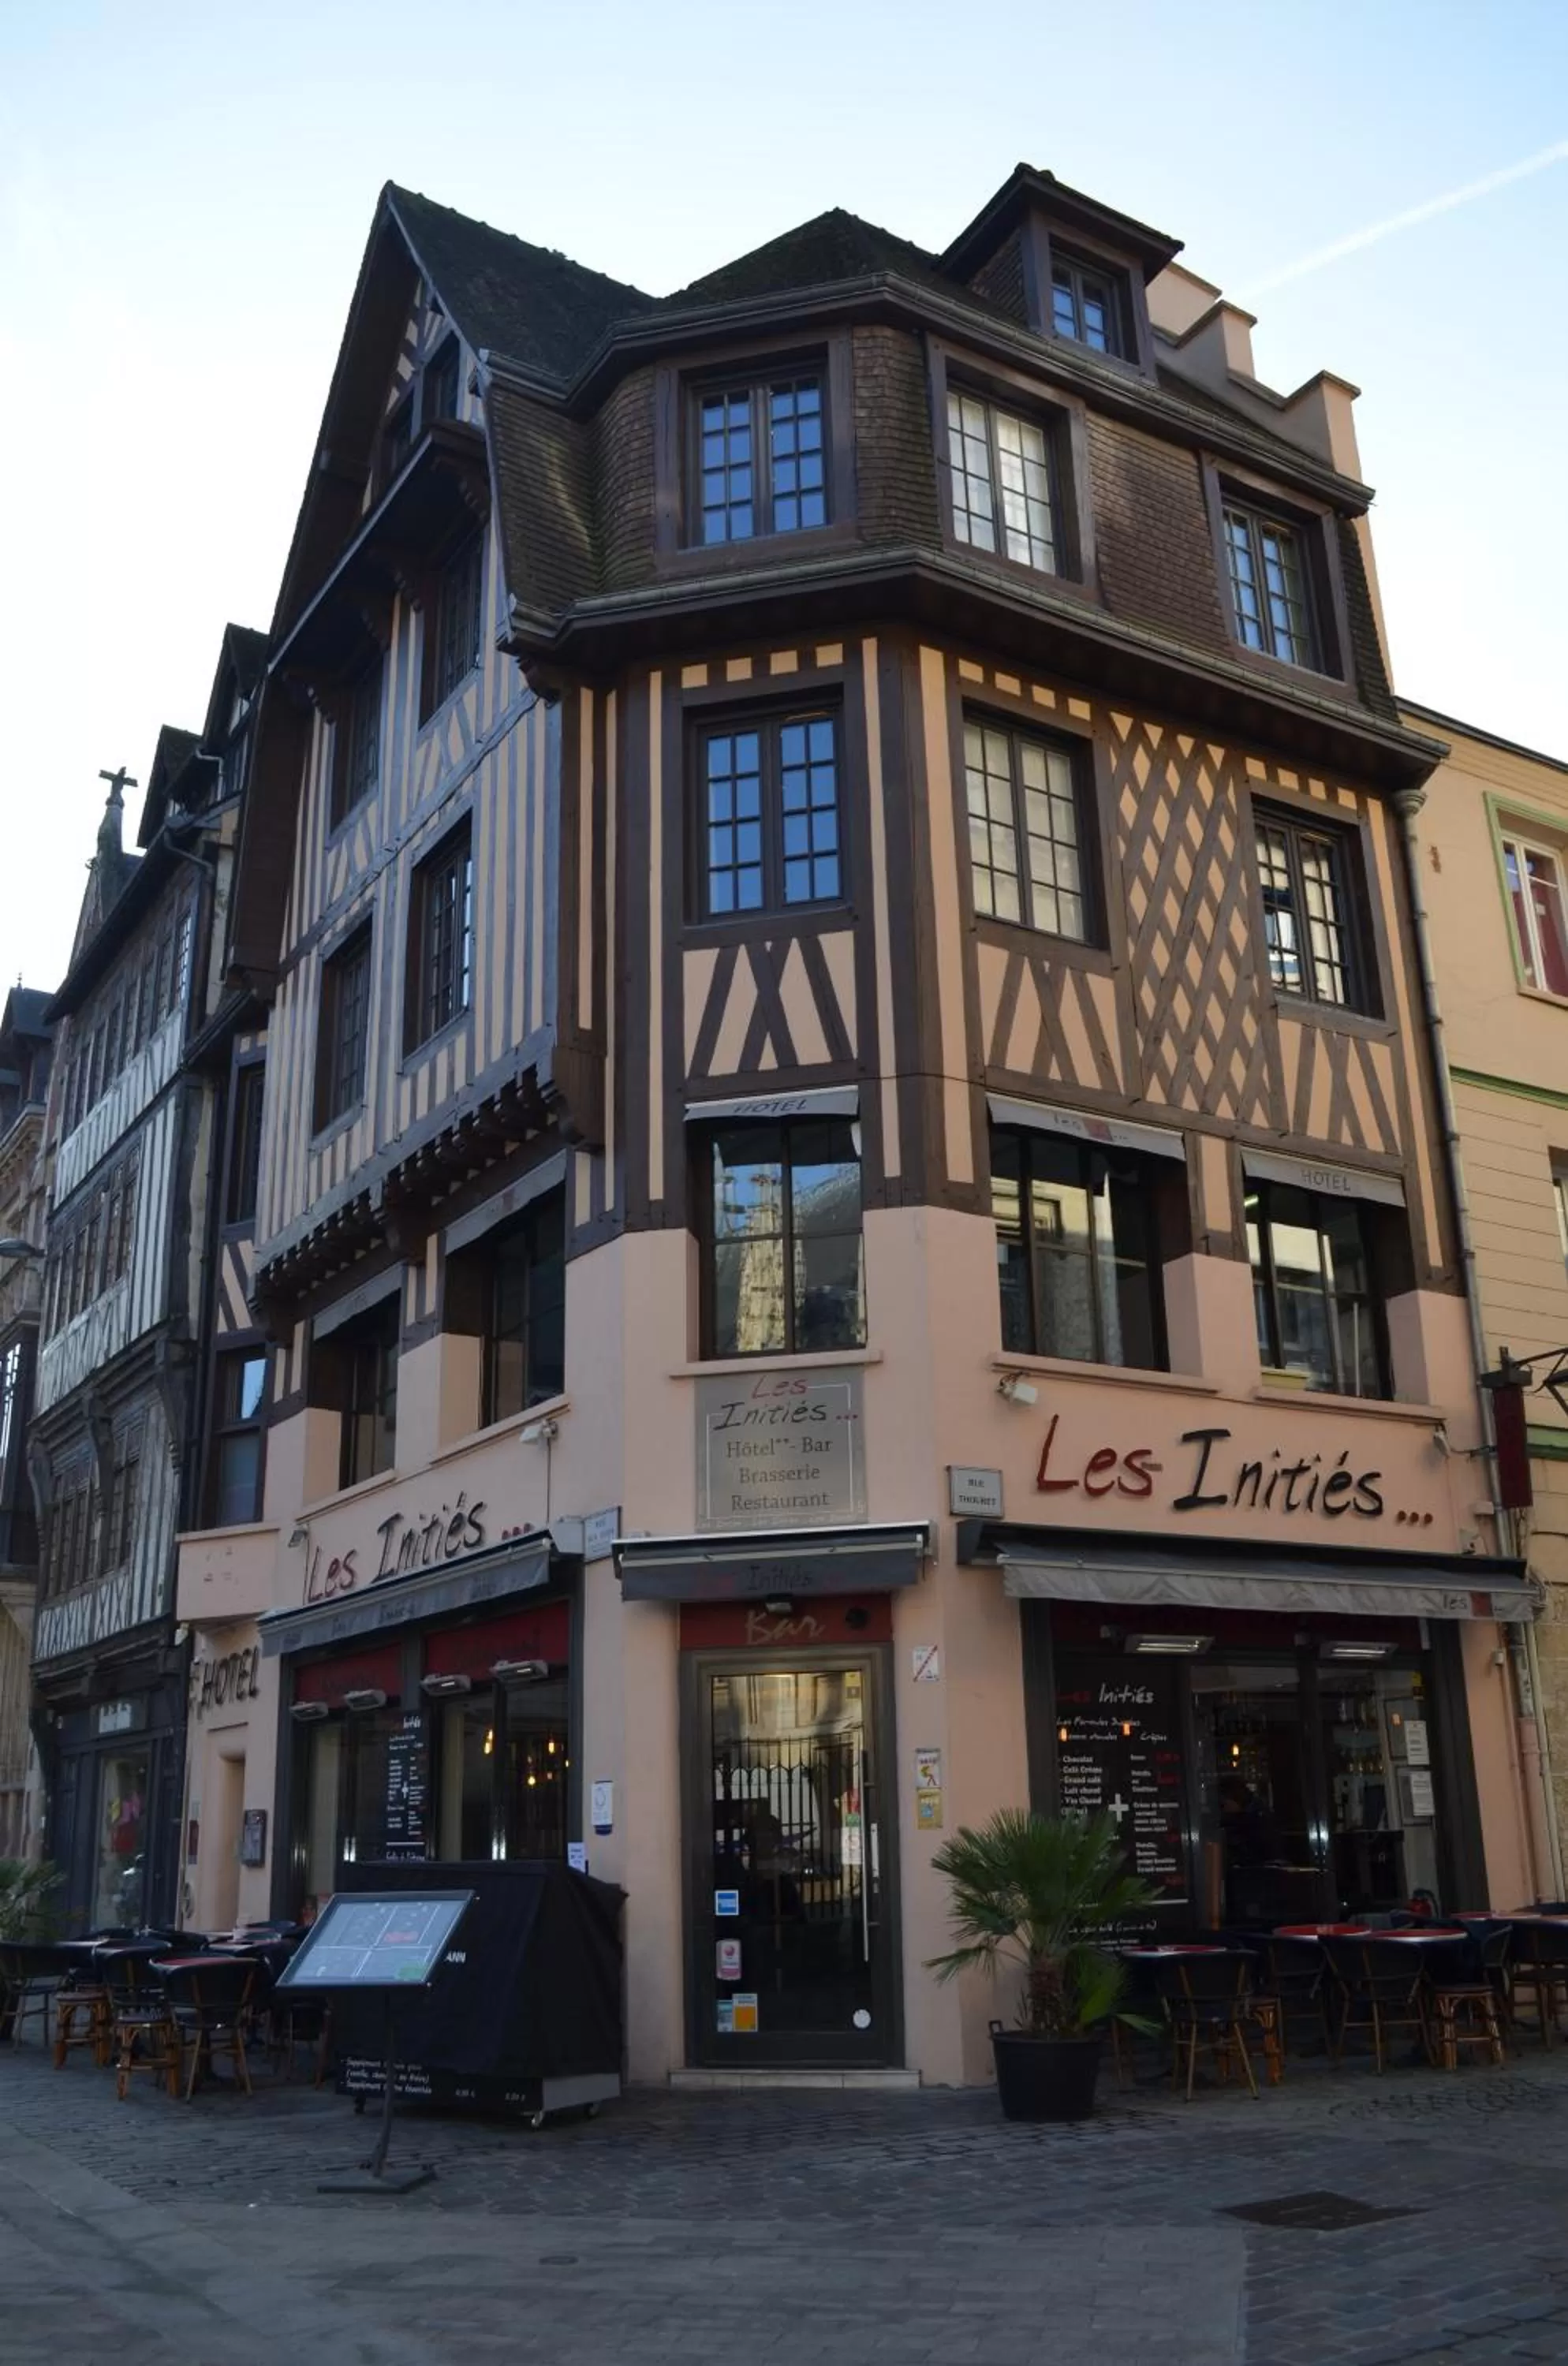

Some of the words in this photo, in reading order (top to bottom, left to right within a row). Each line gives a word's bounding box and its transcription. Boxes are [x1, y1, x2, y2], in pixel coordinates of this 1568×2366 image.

[1300, 1170, 1351, 1192] HOTEL
[752, 1375, 808, 1399] Les
[801, 1436, 834, 1454] Bar
[1036, 1413, 1153, 1498] Les
[738, 1464, 821, 1484] Brasserie
[730, 1491, 831, 1512] Restaurant
[308, 1545, 357, 1603] Les
